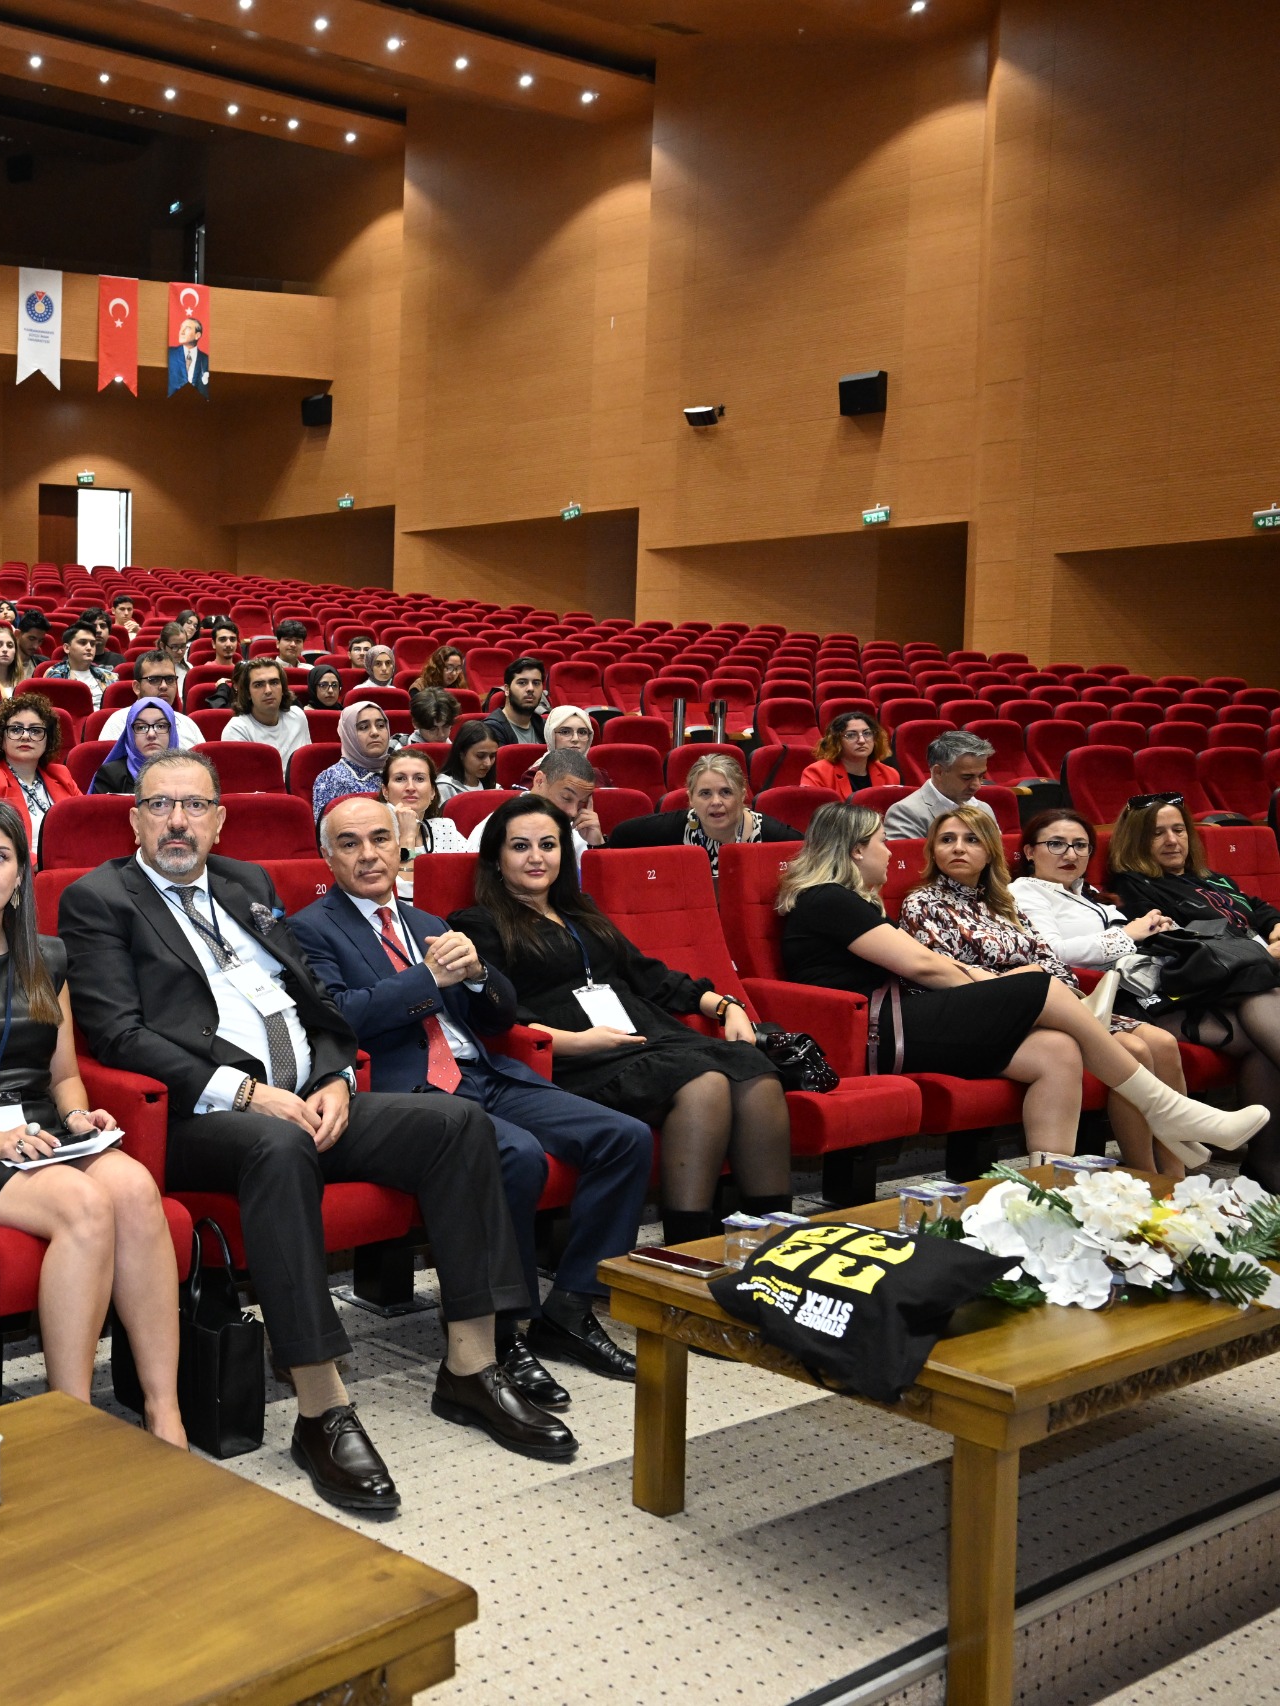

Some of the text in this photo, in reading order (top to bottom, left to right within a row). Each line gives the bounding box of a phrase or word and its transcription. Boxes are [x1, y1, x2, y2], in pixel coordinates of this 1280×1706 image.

[779, 861, 788, 870] 23
[897, 860, 906, 869] 24
[647, 869, 656, 880] 22
[315, 883, 327, 895] 20
[802, 1289, 854, 1324] STICK
[794, 1309, 847, 1338] STORIES
